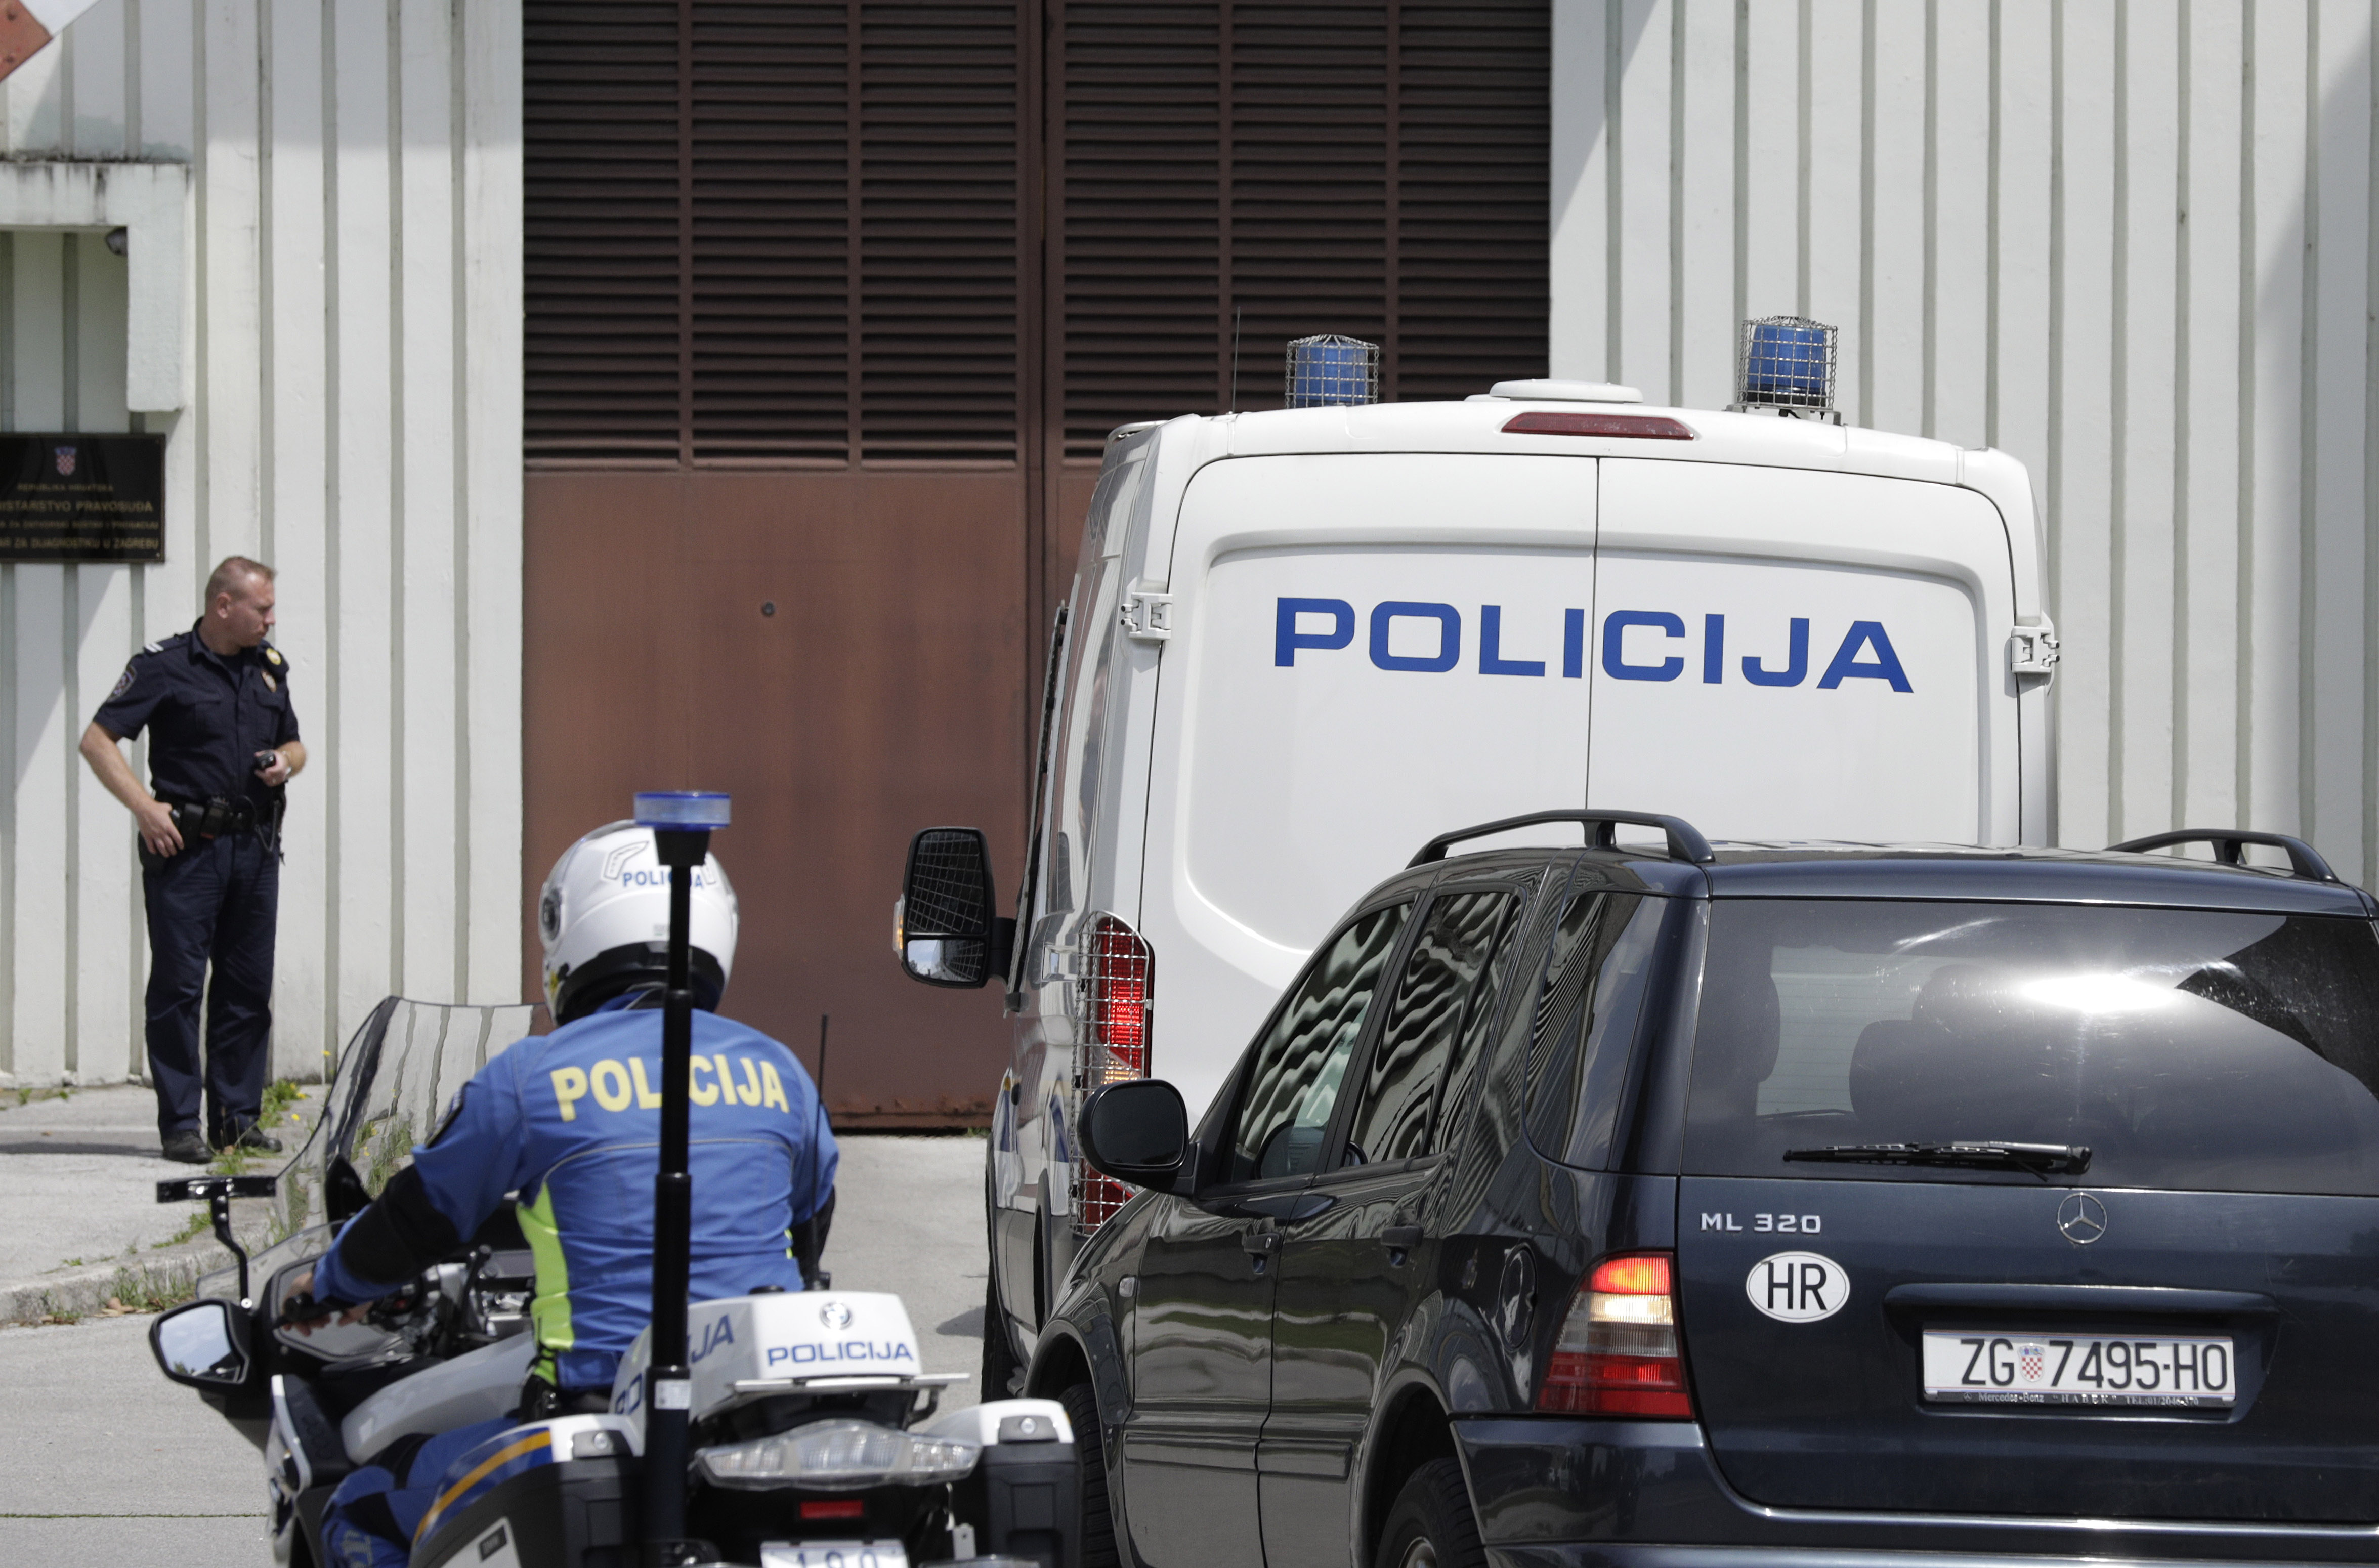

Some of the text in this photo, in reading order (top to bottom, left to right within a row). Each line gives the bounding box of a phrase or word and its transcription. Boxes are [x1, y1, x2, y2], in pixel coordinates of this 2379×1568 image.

[1275, 597, 1914, 693] POLICIJA
[550, 1054, 790, 1122] POLCIJA
[1701, 1213, 1821, 1234] ML 320
[1767, 1262, 1828, 1311] HR
[767, 1341, 913, 1366] POLICIJA
[1961, 1338, 2015, 1386] ZG
[1979, 1392, 2044, 1404] Mercedes-Benz
